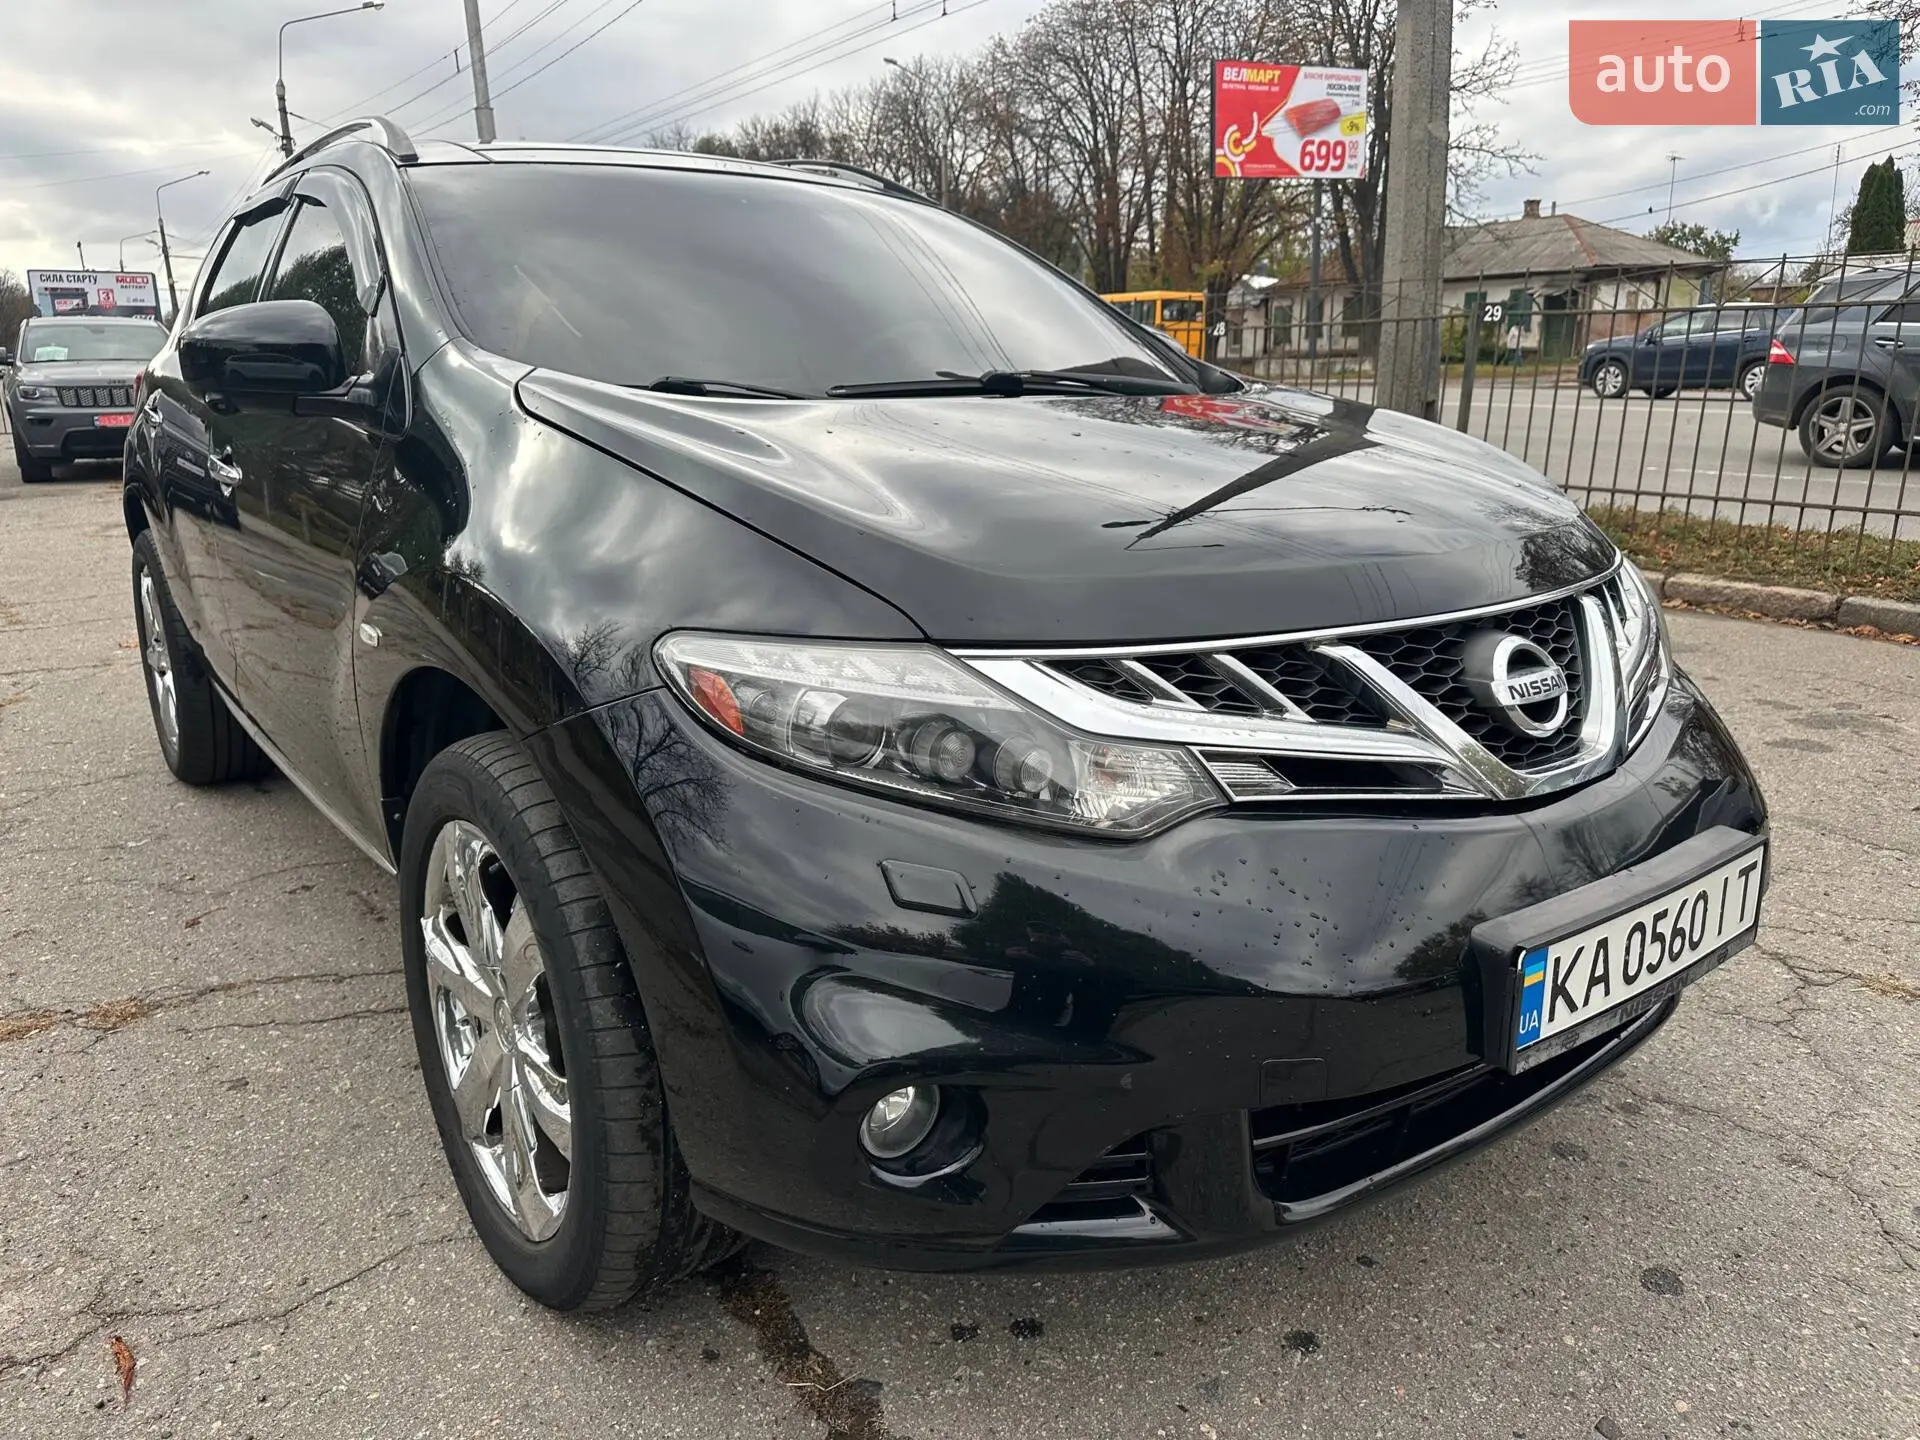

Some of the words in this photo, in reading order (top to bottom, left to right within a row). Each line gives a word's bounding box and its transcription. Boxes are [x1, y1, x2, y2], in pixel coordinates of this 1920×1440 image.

[1223, 67, 1281, 84] ВЕЛМАРТ
[1300, 139, 1346, 172] 699
[40, 273, 64, 283] СИЛА
[66, 274, 97, 285] СТАРТУ
[102, 290, 111, 301] 3
[1483, 304, 1503, 321] 29
[1507, 674, 1567, 700] NISSAN
[1519, 1010, 1539, 1034] UA
